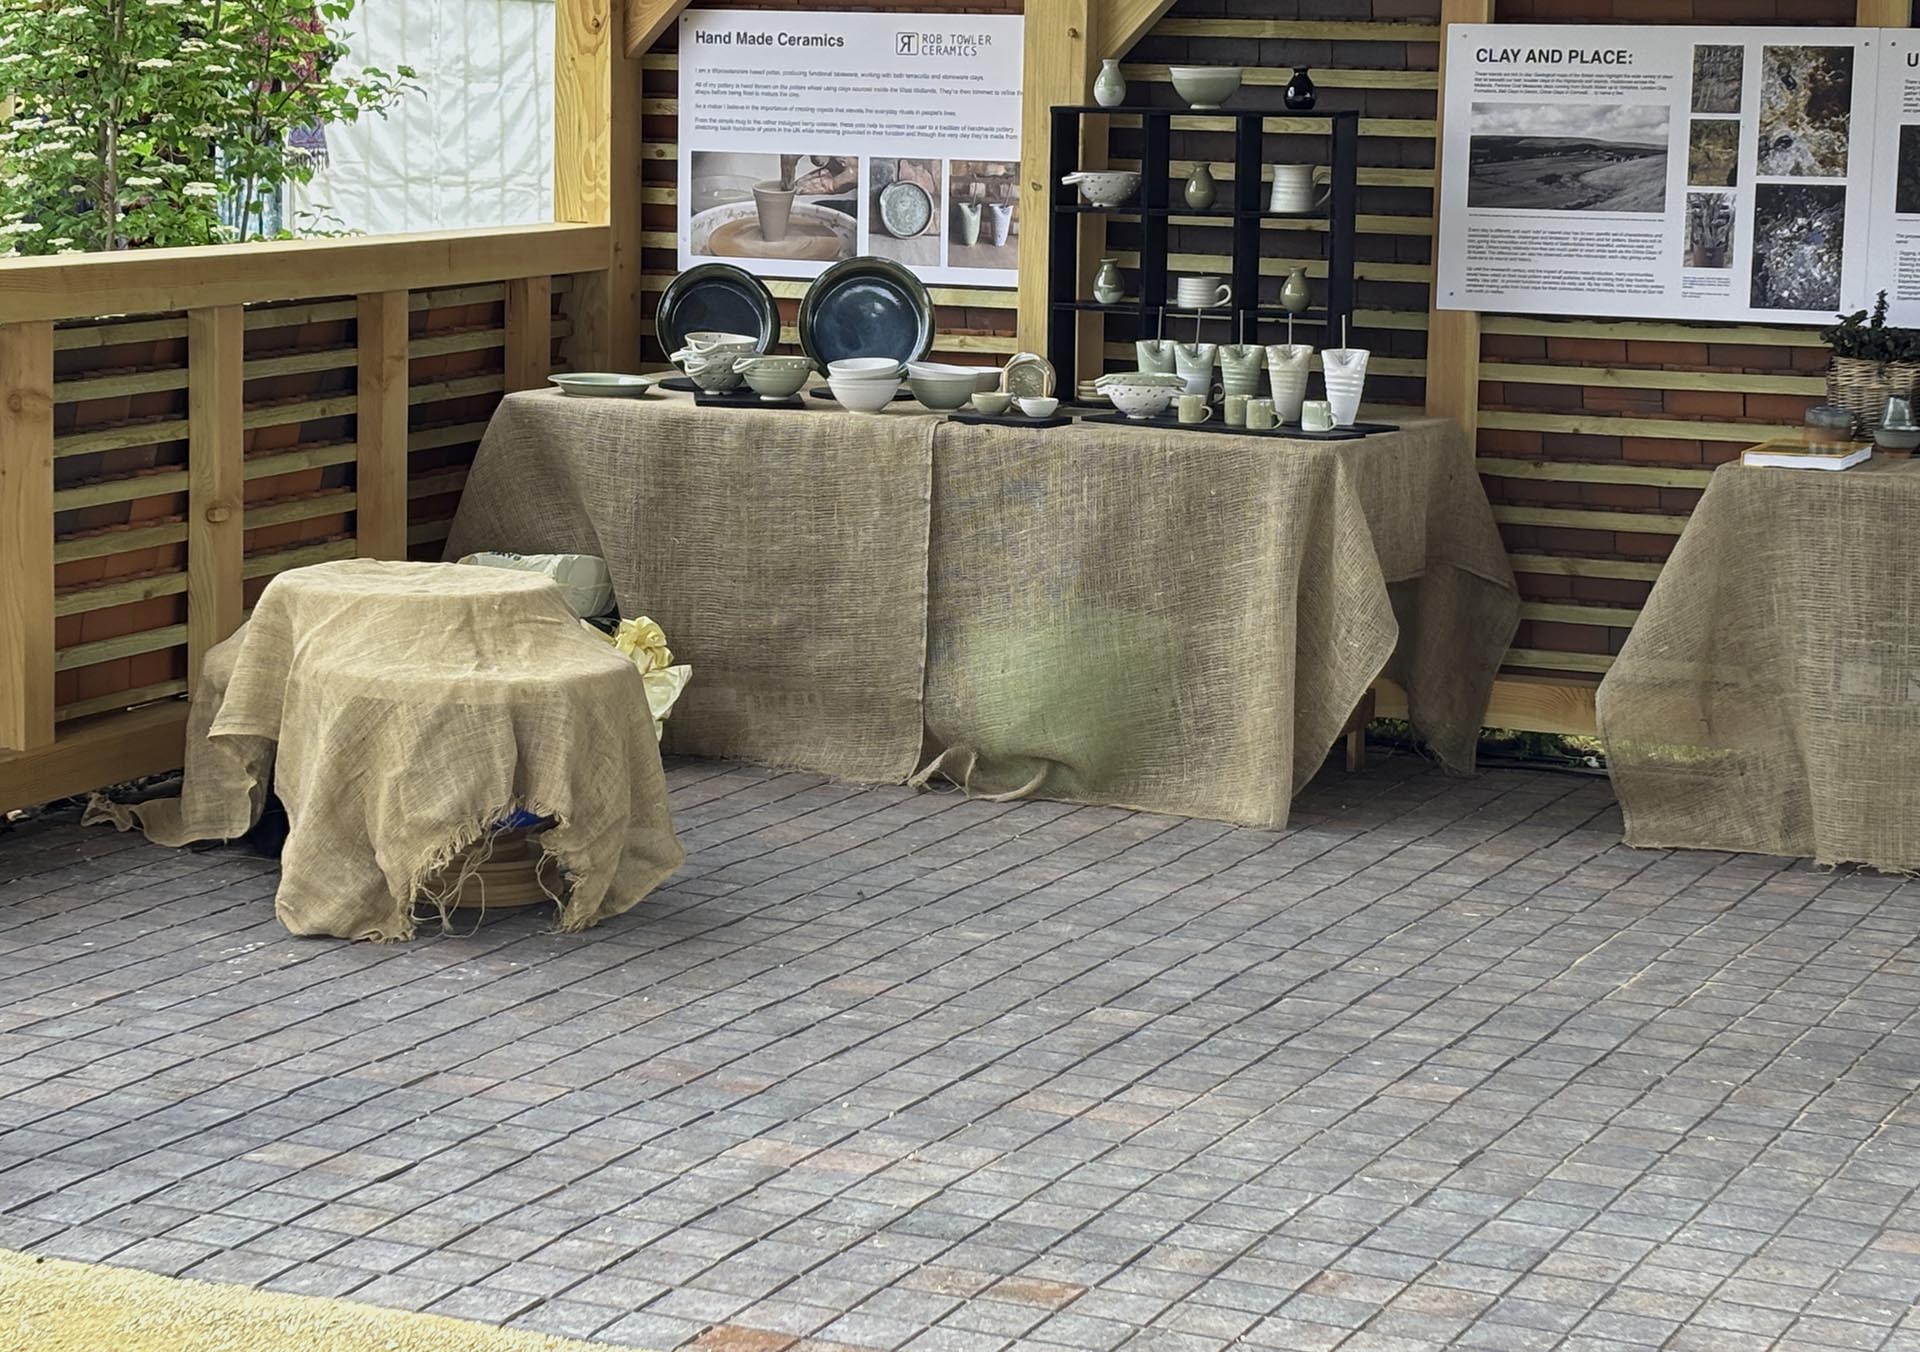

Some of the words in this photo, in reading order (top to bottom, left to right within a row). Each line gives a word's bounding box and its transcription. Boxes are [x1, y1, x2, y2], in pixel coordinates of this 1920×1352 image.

[695, 31, 732, 45] Hand
[736, 32, 774, 46] Made
[778, 32, 845, 47] Ceramics
[922, 34, 943, 44] ROB
[950, 34, 992, 46] TOWLER
[922, 45, 978, 56] CERAMICS
[1476, 48, 1521, 64] CLAY
[1525, 48, 1563, 64] AND
[1567, 48, 1634, 64] PLACE:
